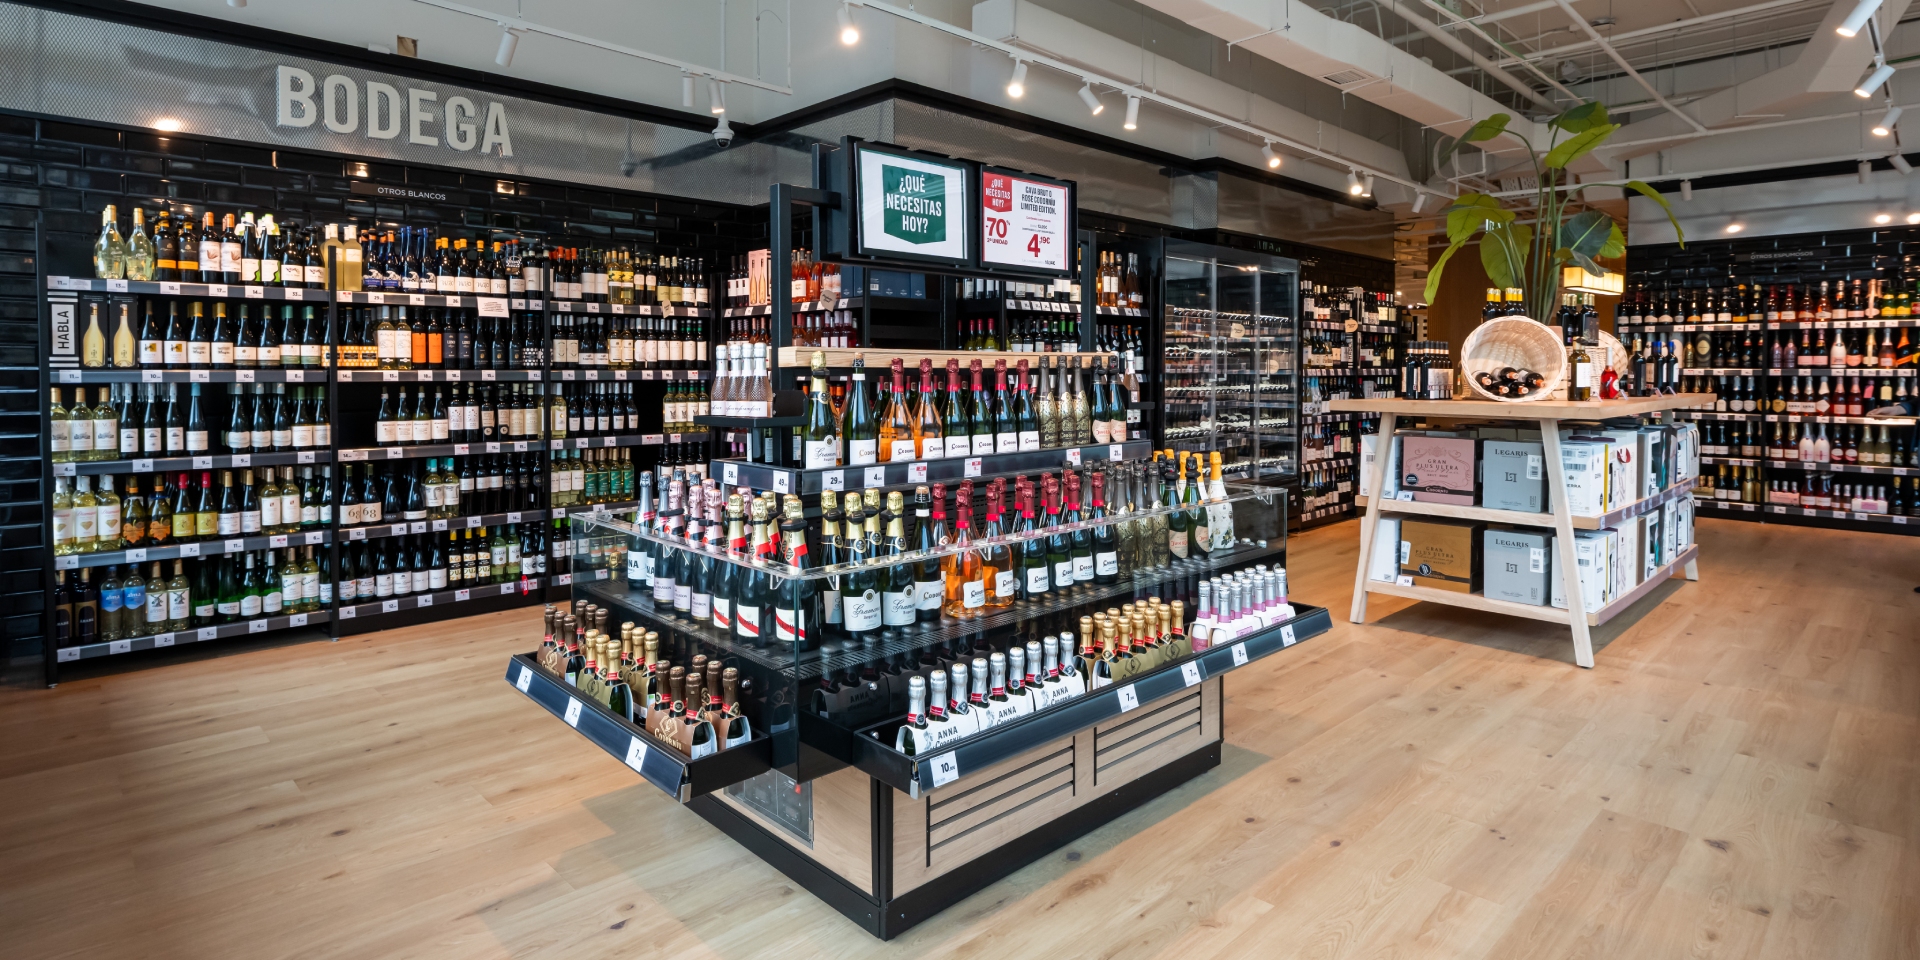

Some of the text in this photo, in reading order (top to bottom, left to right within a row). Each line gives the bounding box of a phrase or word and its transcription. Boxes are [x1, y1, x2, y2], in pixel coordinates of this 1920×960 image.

[277, 65, 513, 157] BODEGA
[900, 174, 926, 194] ¿QUÉ
[991, 179, 1004, 188] ¿QUÉ
[378, 186, 446, 200] OTROS BLANCOS
[986, 188, 1010, 200] NECESITAS
[1025, 186, 1036, 196] CAVA
[1037, 188, 1048, 196] BRUT
[886, 193, 942, 216] NECESITAS
[992, 198, 1004, 208] HOY?
[1020, 202, 1038, 212] LIMITED
[902, 214, 928, 234] HOY?
[57, 310, 69, 349] HABLA
[362, 506, 377, 518] 68
[1495, 539, 1529, 548] LEGARIS
[1052, 686, 1068, 698] ANNA
[998, 706, 1017, 718] ANNA
[937, 726, 958, 739] ANNA
